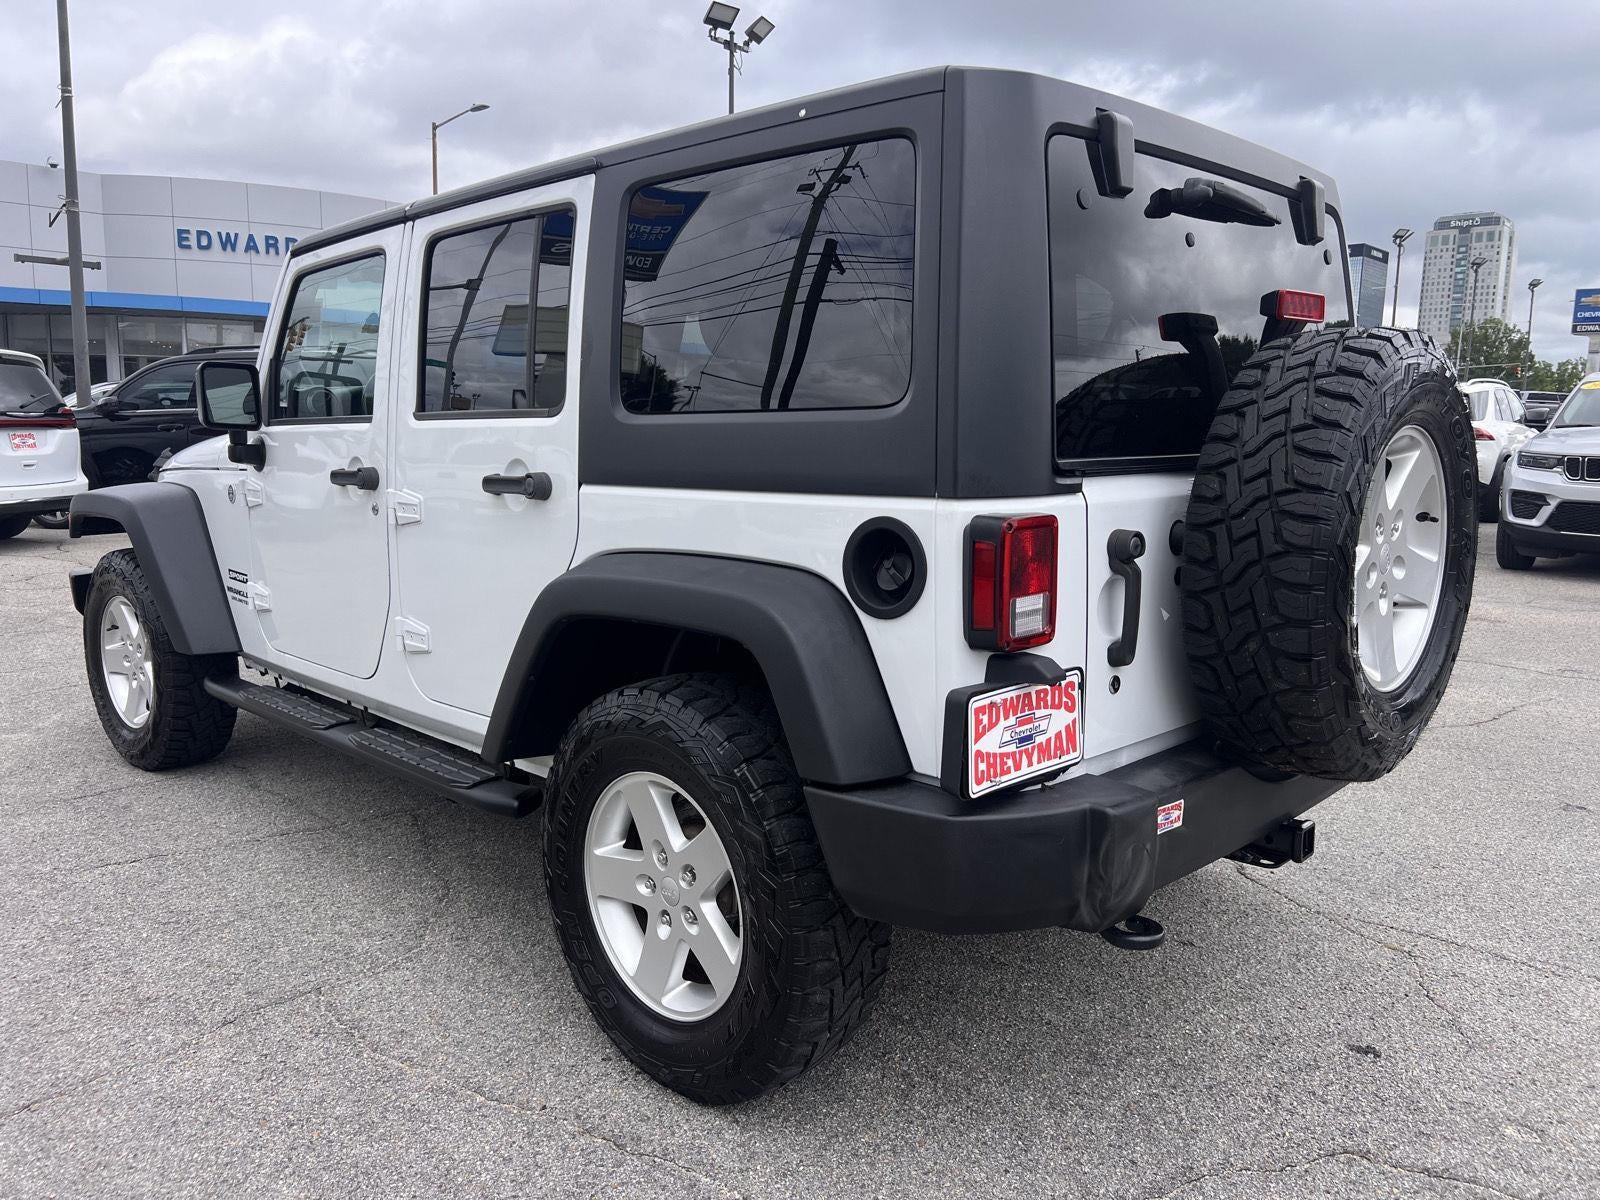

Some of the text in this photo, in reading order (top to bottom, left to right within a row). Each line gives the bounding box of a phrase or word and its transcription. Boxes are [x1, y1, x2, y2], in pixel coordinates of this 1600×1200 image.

[1450, 219, 1473, 228] Shipt
[974, 681, 1076, 746] EDWARDS
[1010, 722, 1041, 739] Chevrolet
[974, 717, 1078, 786] CHEVYMAN
